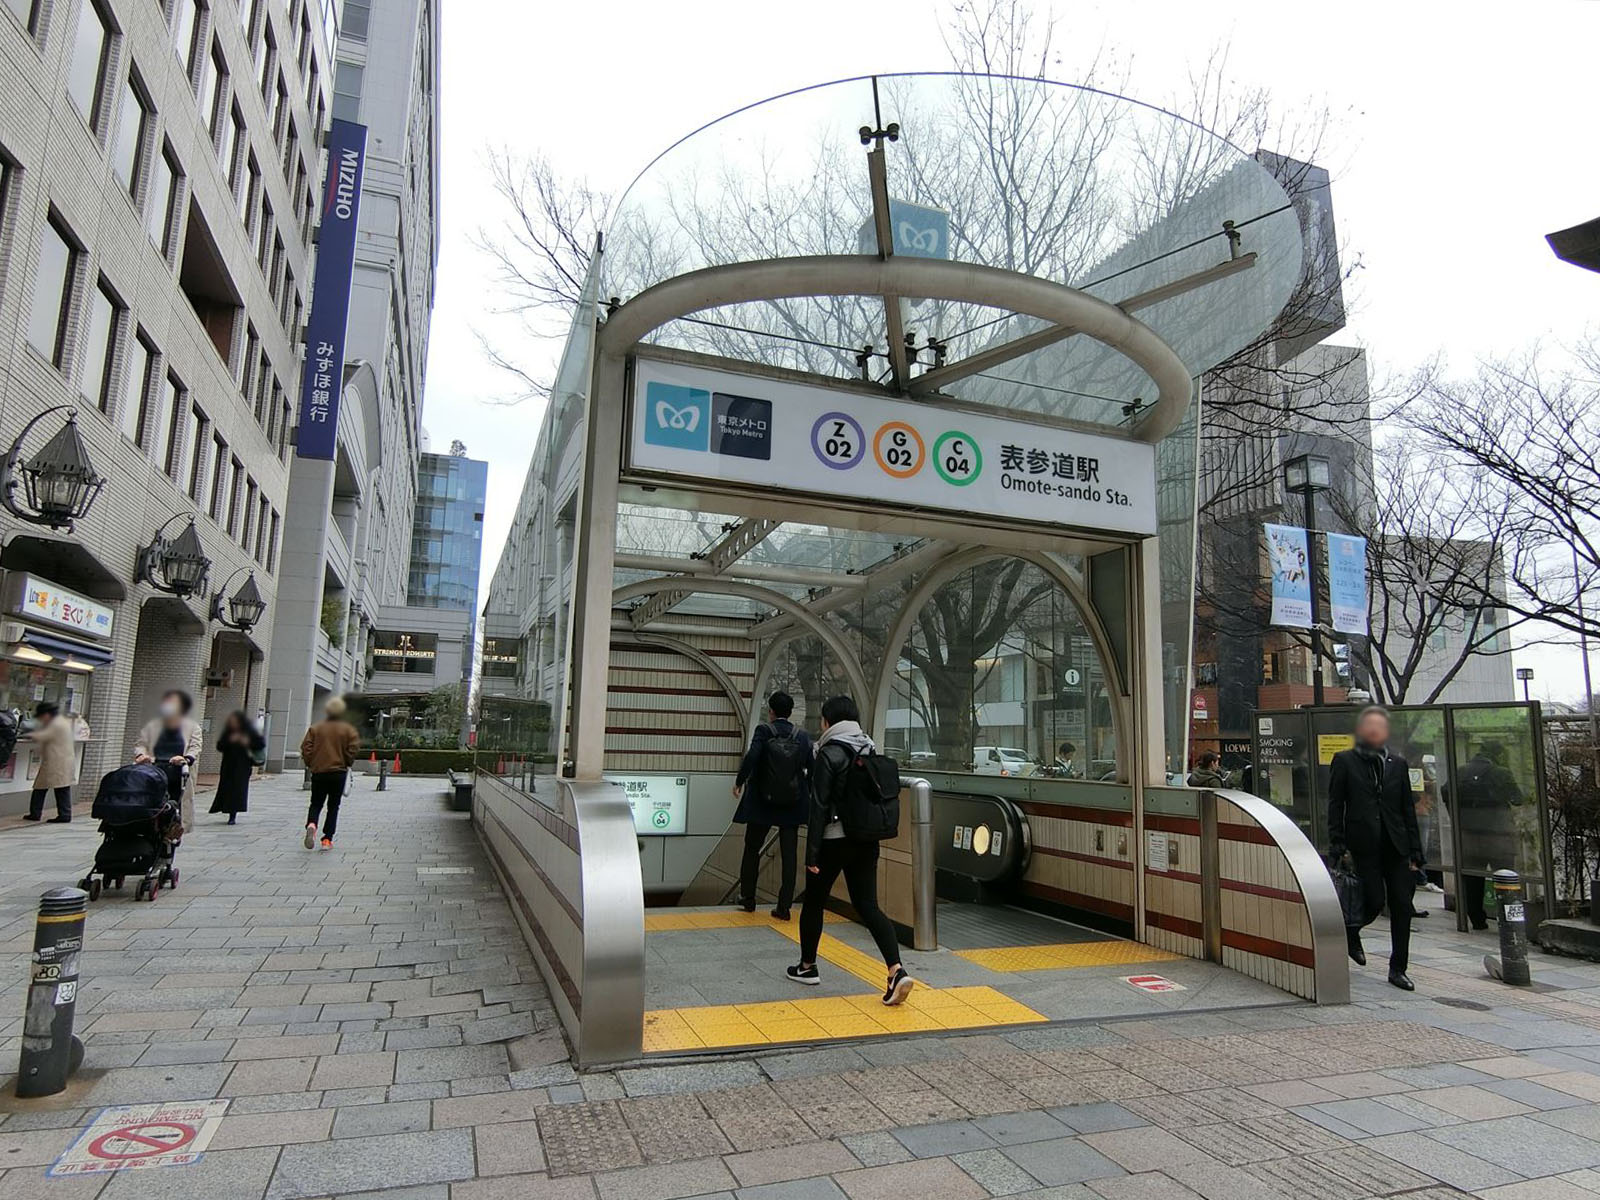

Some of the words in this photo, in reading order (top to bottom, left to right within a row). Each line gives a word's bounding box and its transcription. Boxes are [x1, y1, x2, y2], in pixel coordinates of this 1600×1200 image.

[336, 148, 359, 220] MIZUHO
[310, 341, 335, 422] みずほ銀行
[717, 414, 767, 430] 東京メトロ
[833, 422, 846, 438] Z
[719, 425, 741, 436] Tokyo
[742, 429, 763, 439] Metro
[893, 431, 907, 447] G
[825, 439, 852, 458] 02
[953, 441, 963, 455] C
[887, 448, 912, 467] 02
[946, 457, 970, 474] 04
[1000, 444, 1100, 483] 表参道駅
[1001, 473, 1101, 502] Omote-sando
[1106, 488, 1133, 507] Sta.
[374, 648, 403, 657] STRINGS
[1225, 743, 1252, 753] LOEWE
[1259, 738, 1294, 747] SMOKING
[1260, 748, 1279, 757] AREA
[115, 1115, 181, 1124] SMOKING
[182, 1113, 203, 1121] NO
